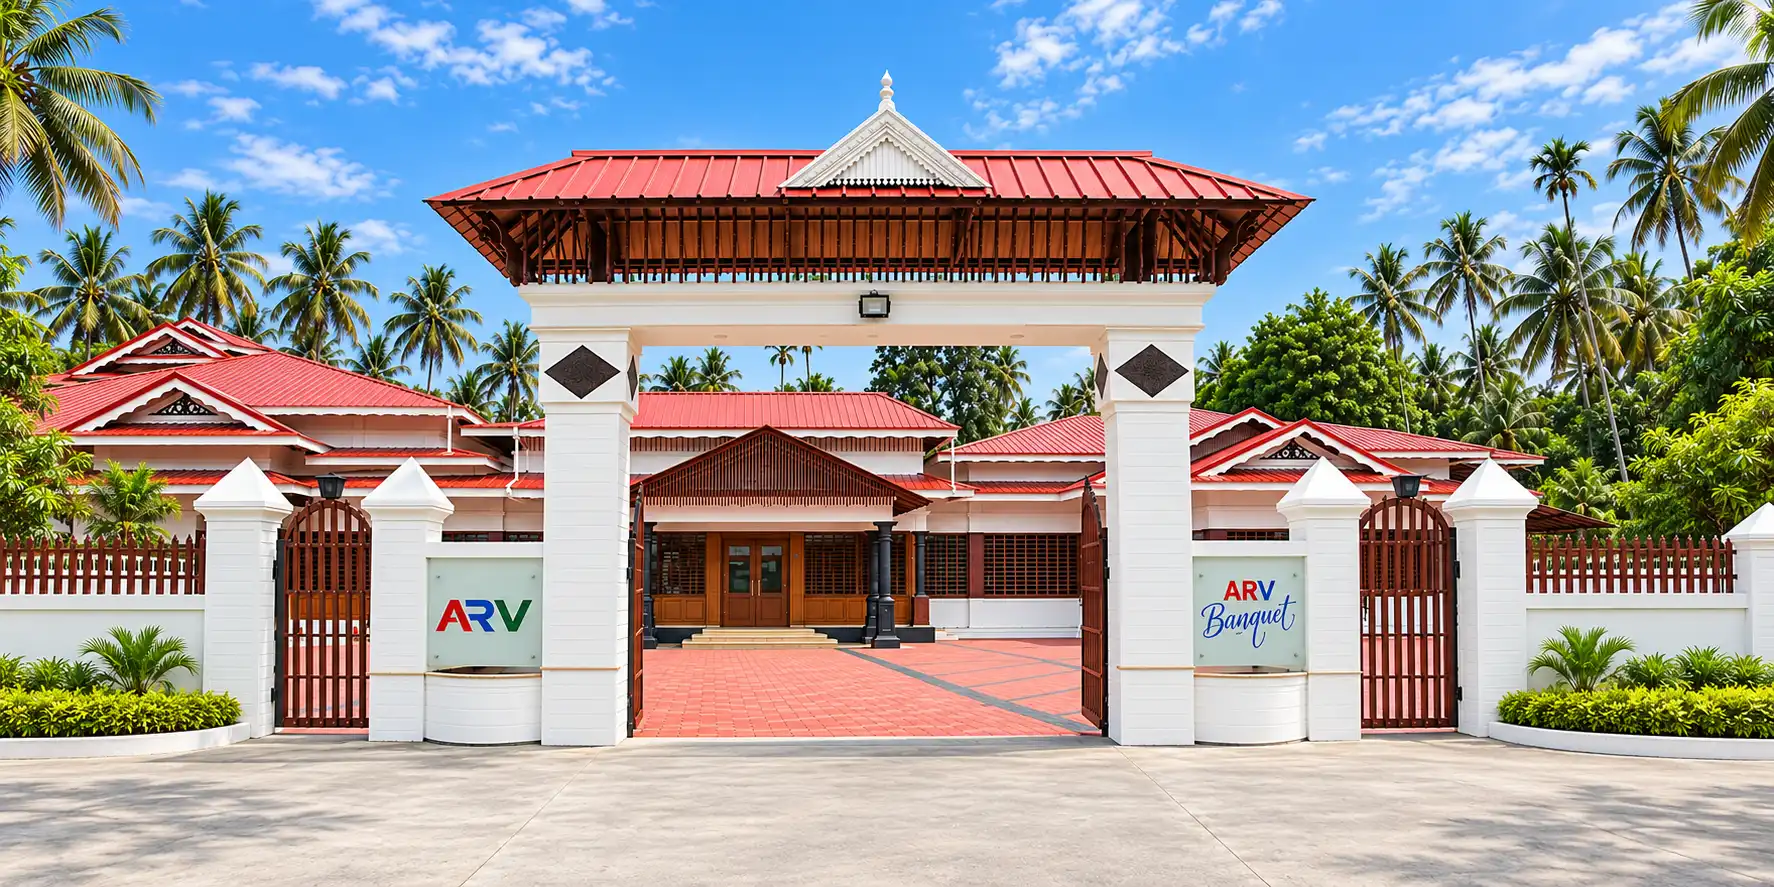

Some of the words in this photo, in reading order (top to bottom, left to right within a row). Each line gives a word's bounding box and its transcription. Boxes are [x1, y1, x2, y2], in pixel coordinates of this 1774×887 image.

[1223, 580, 1276, 601] ARV
[436, 599, 533, 632] ARV
[1201, 595, 1297, 648] Banquet
